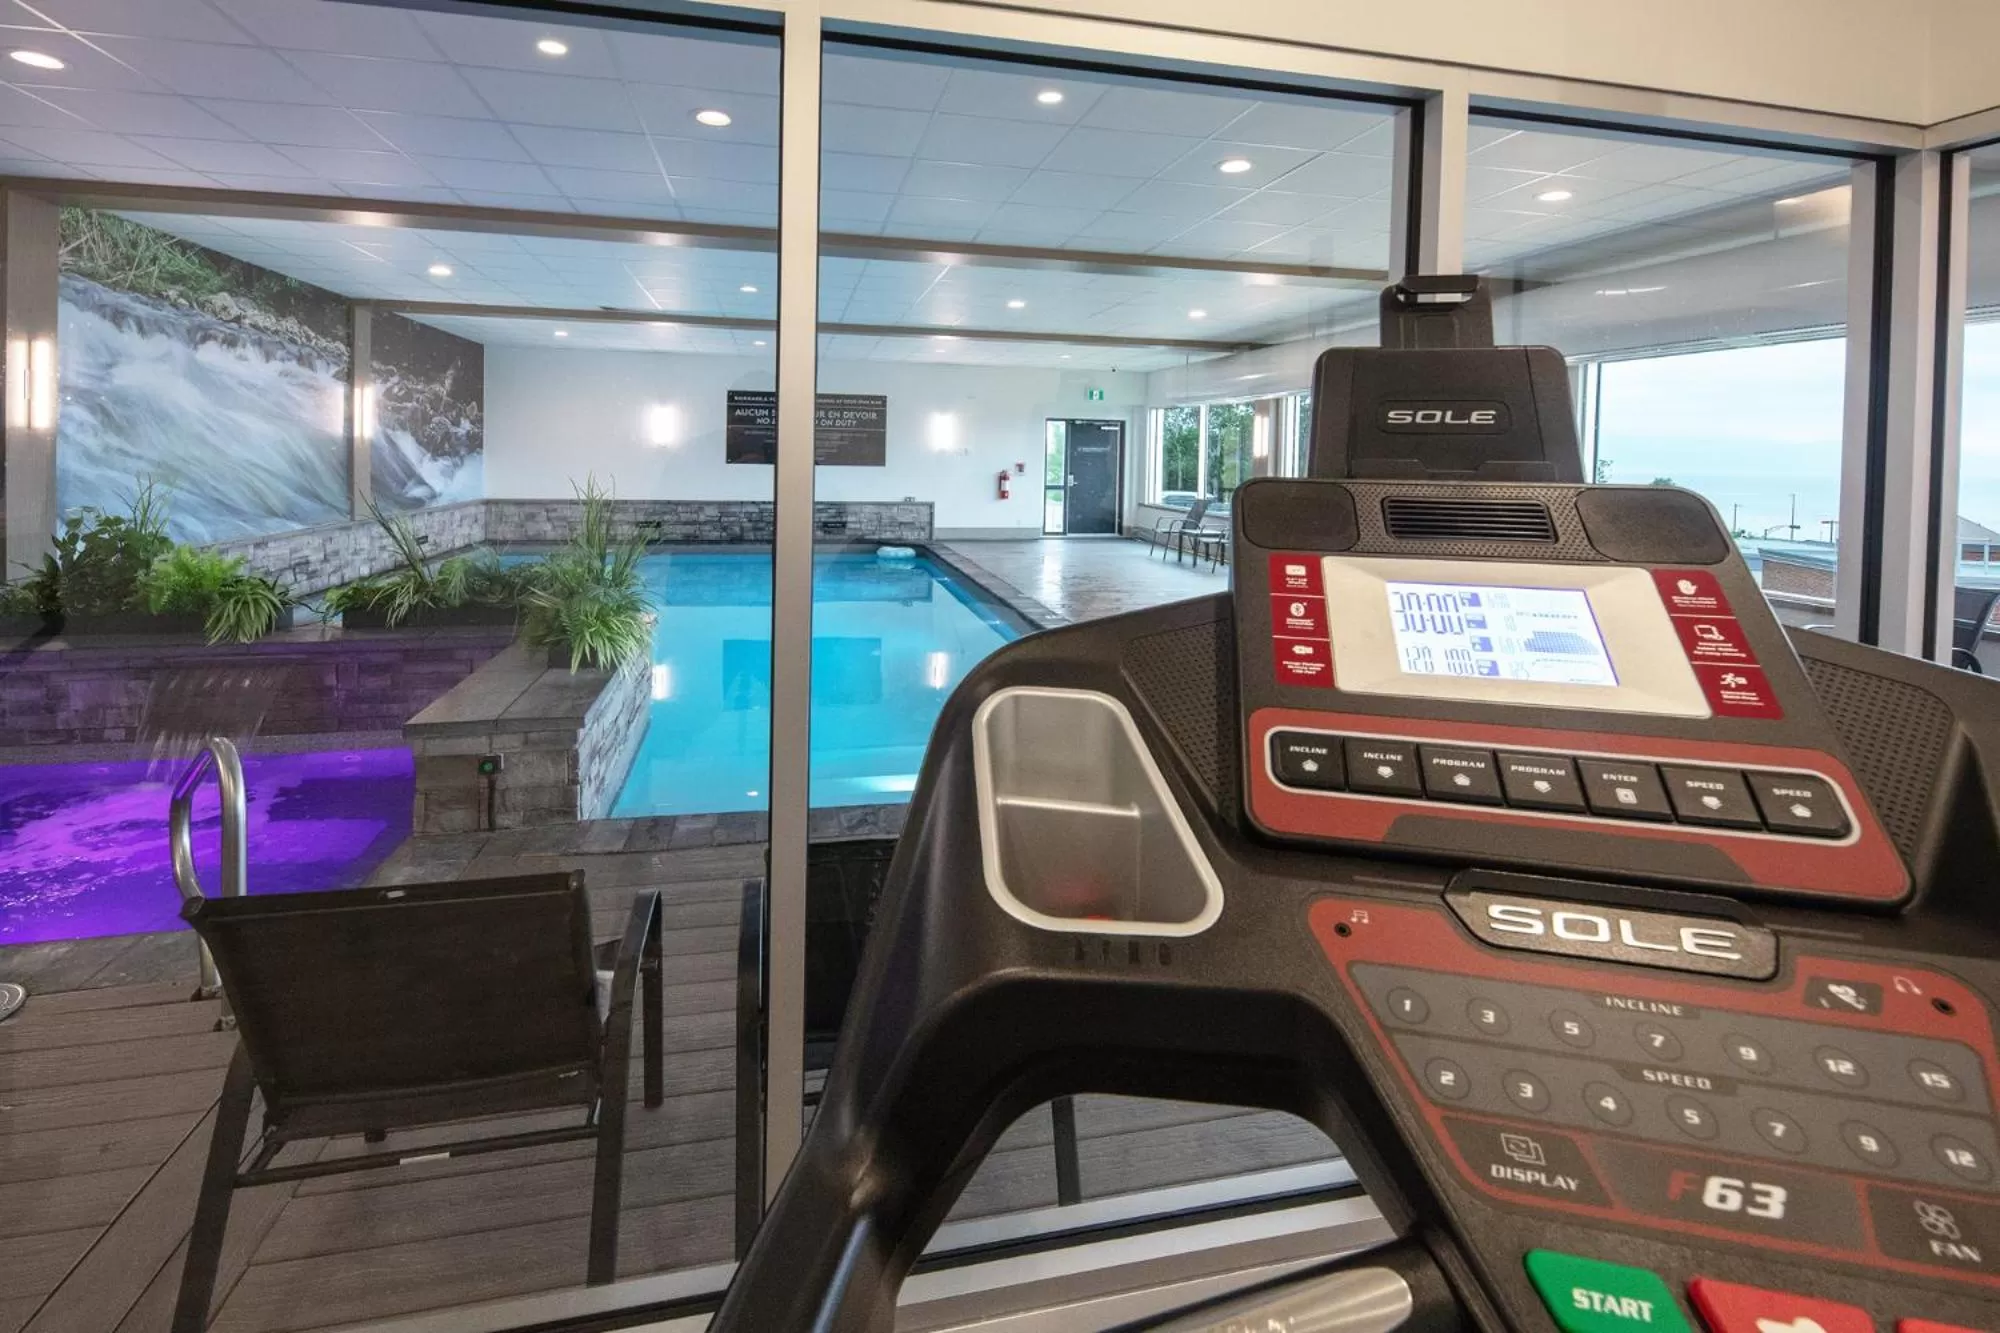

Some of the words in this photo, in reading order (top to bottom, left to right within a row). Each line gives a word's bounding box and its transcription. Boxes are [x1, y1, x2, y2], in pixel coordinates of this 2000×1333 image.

[735, 408, 769, 417] AUCUN
[843, 411, 878, 420] DEVOIR
[756, 417, 770, 425] NO
[835, 419, 857, 427] DUTY
[1387, 410, 1497, 424] SOLE
[1289, 745, 1328, 755] INCLINE
[1363, 751, 1403, 762] INCLINE
[1432, 757, 1486, 769] PROGRAM
[1511, 764, 1566, 777] PROGRAM
[1602, 773, 1638, 783] ENTER
[1686, 780, 1725, 791] SPEED
[1772, 788, 1813, 798] SPEED
[1488, 904, 1742, 961] SOLE
[1605, 996, 1684, 1017] INCLINE
[1404, 998, 1412, 1012] 1
[1481, 1009, 1496, 1024] 3
[1563, 1021, 1580, 1036] 5
[1650, 1033, 1665, 1048] 7
[1738, 1046, 1758, 1062] 9
[1825, 1057, 1857, 1076] 12
[1919, 1071, 1951, 1090] 15
[1642, 1068, 1713, 1092] SPEED
[1439, 1070, 1455, 1086] 2
[1519, 1082, 1533, 1098] 3
[1600, 1095, 1617, 1112] 4
[1683, 1108, 1701, 1125] 5
[1768, 1121, 1786, 1138] 7
[1858, 1135, 1880, 1153] 9
[1945, 1148, 1977, 1169] 12
[1490, 1163, 1580, 1192] DISPLAY
[1667, 1170, 1788, 1220] F63
[1929, 1239, 1982, 1263] FAN
[1571, 1287, 1654, 1323] START
